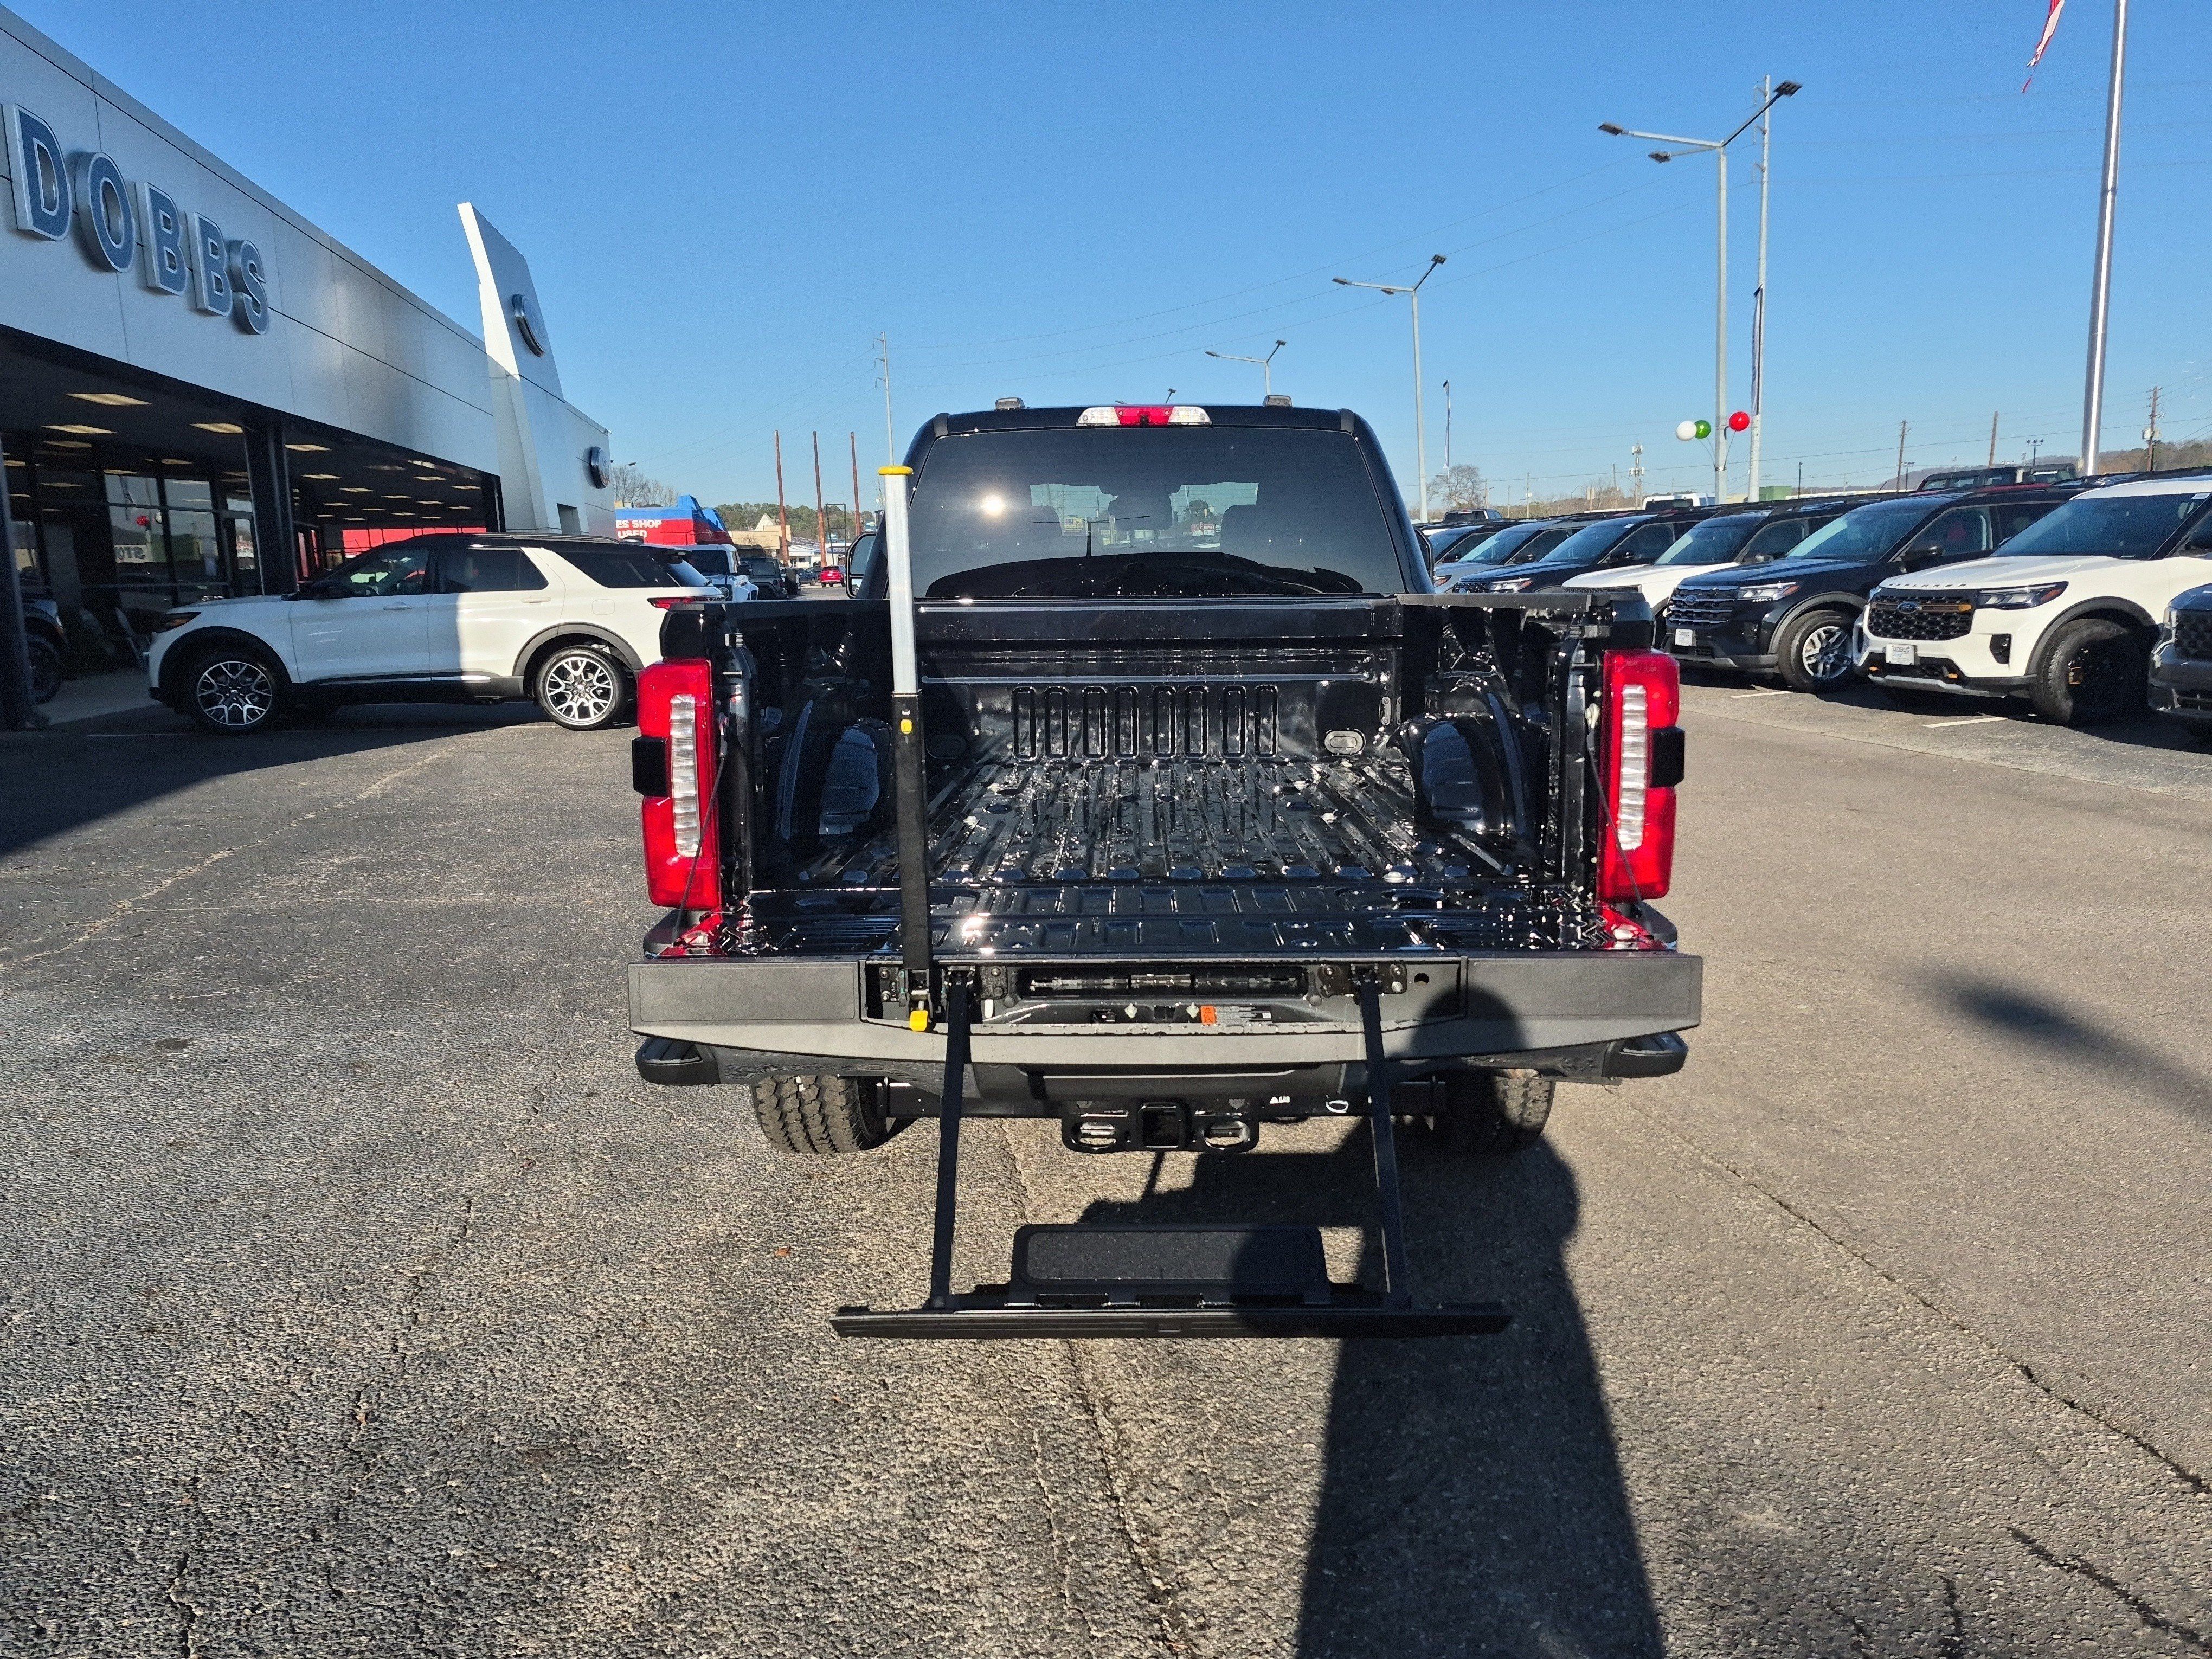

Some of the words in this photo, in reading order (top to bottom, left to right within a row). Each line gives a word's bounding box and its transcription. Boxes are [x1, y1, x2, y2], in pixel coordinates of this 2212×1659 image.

[1, 103, 270, 335] DOBBS
[632, 520, 662, 529] SHOP
[618, 530, 648, 539] USED
